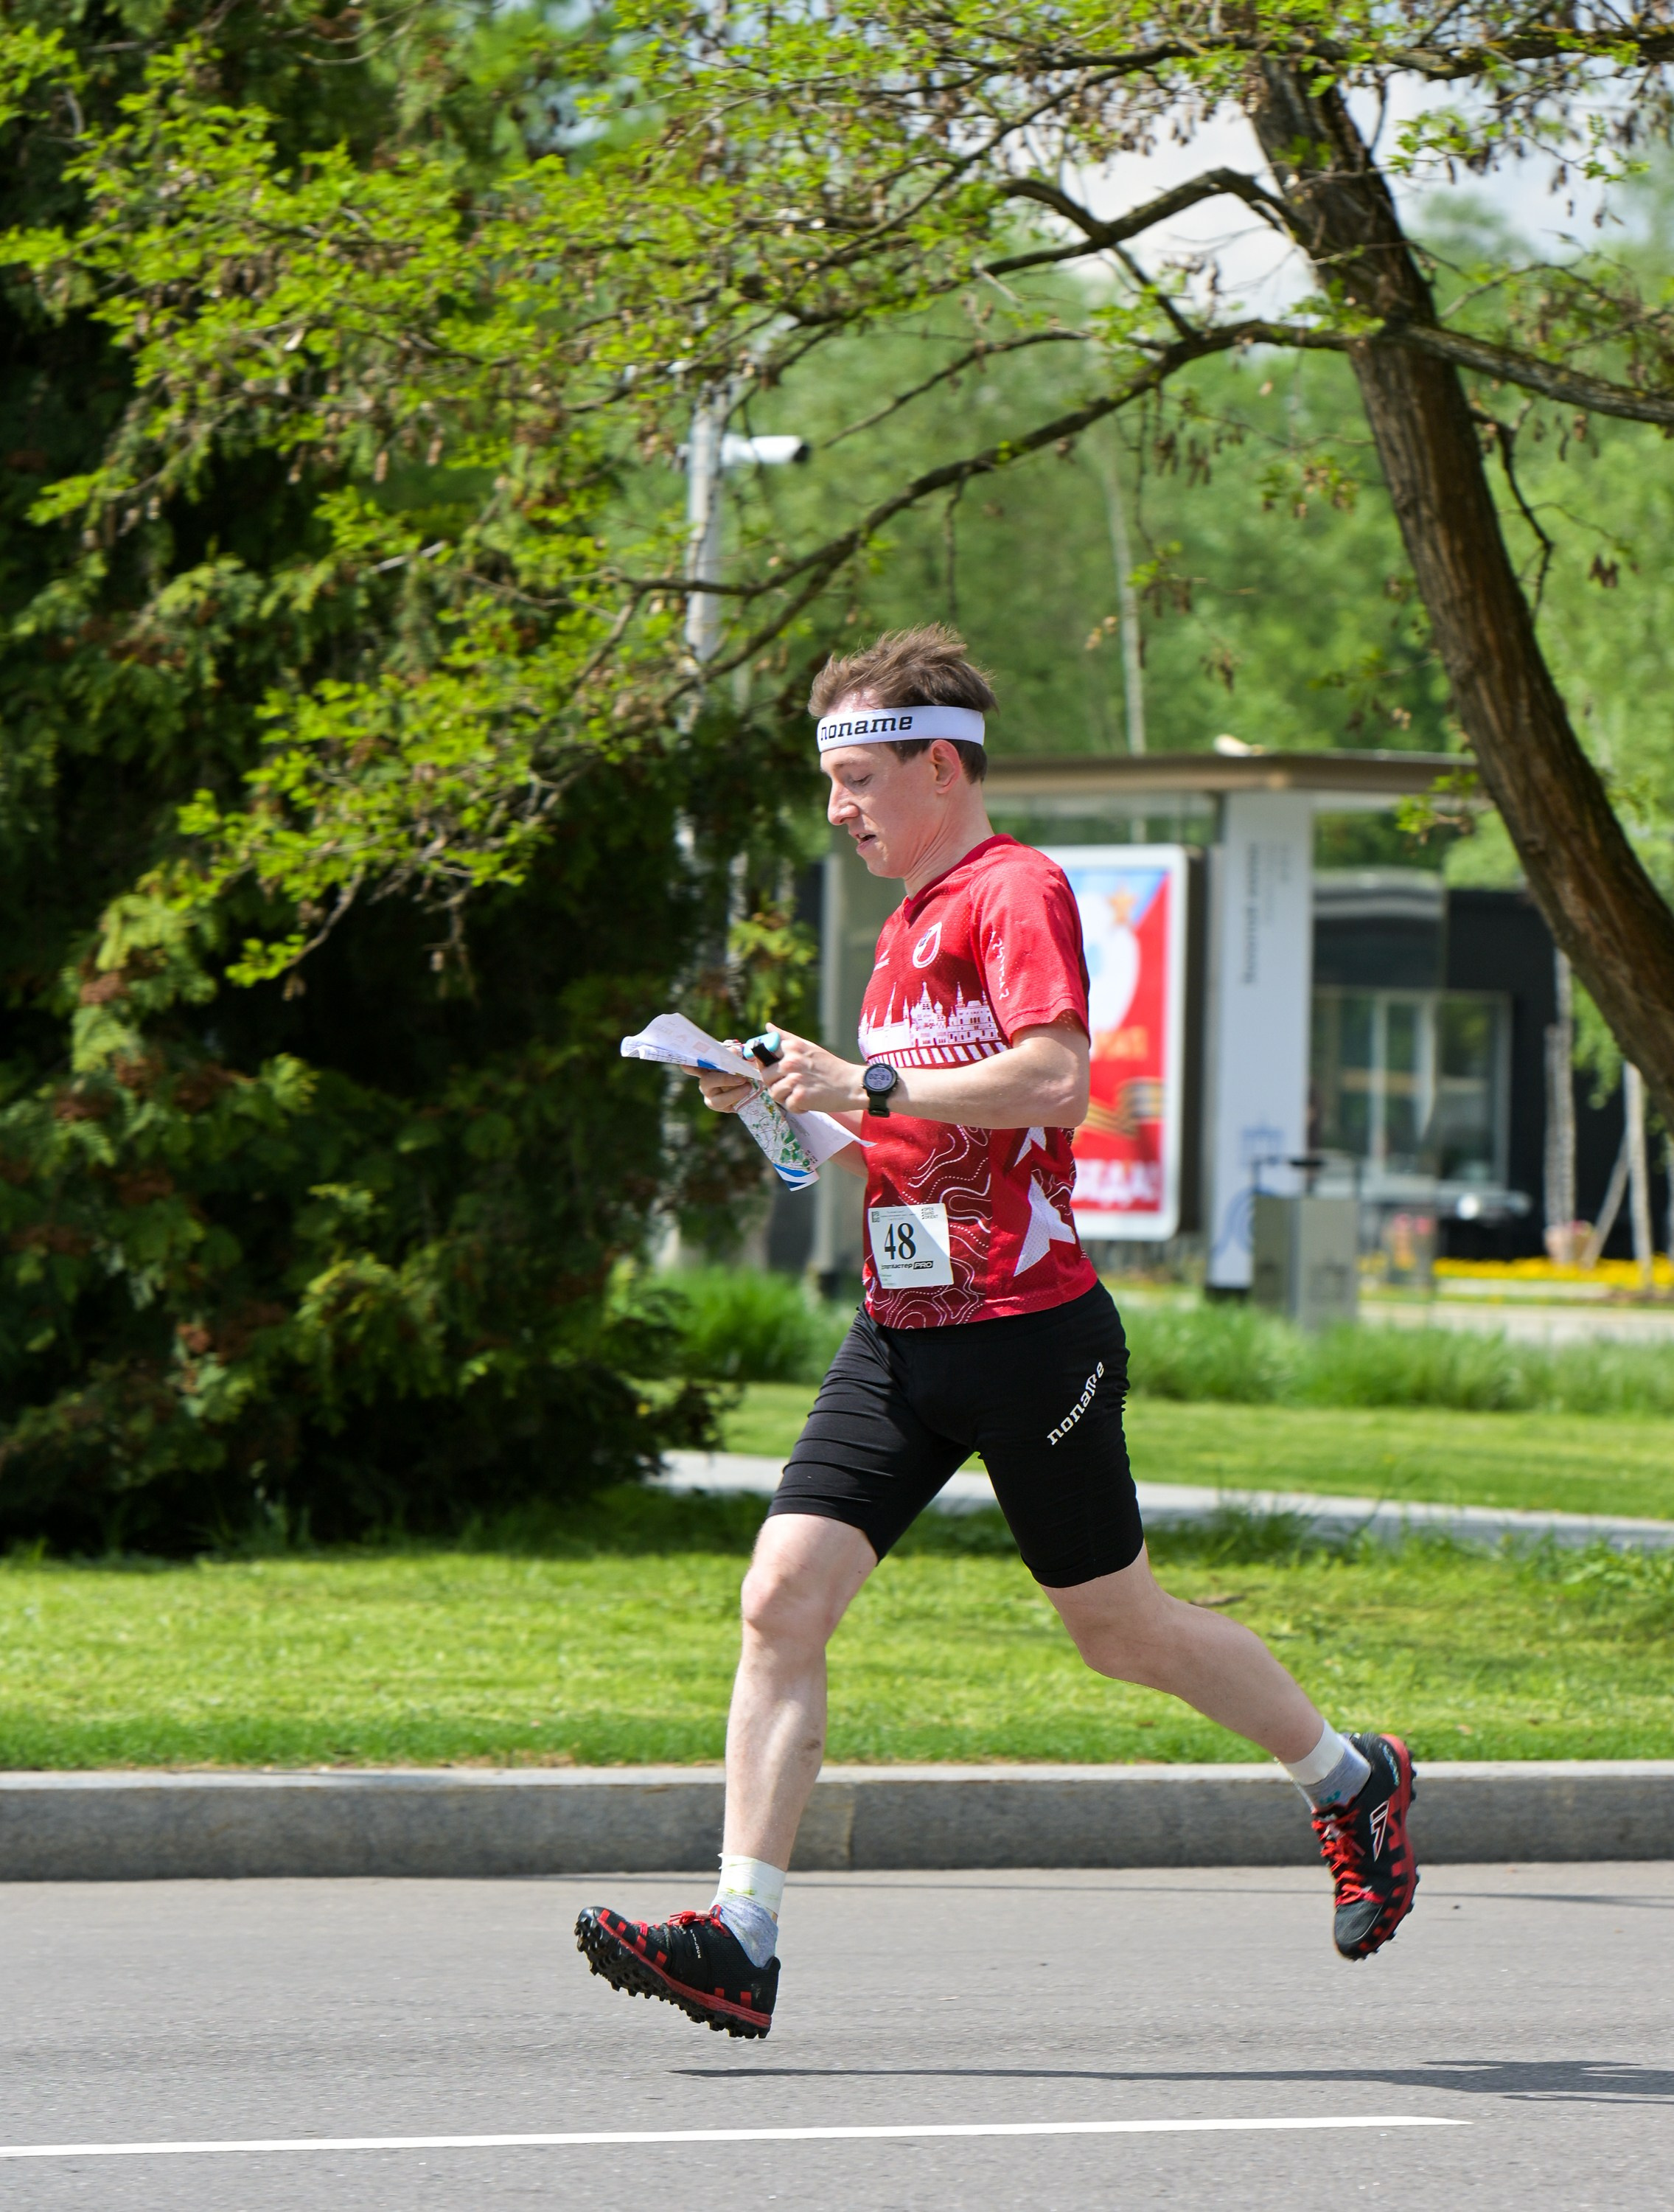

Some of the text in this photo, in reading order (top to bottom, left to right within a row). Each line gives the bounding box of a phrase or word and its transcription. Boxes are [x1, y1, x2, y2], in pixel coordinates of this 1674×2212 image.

[820, 715, 913, 741] noname
[885, 1222, 916, 1260] 48
[1047, 1361, 1104, 1445] noname
